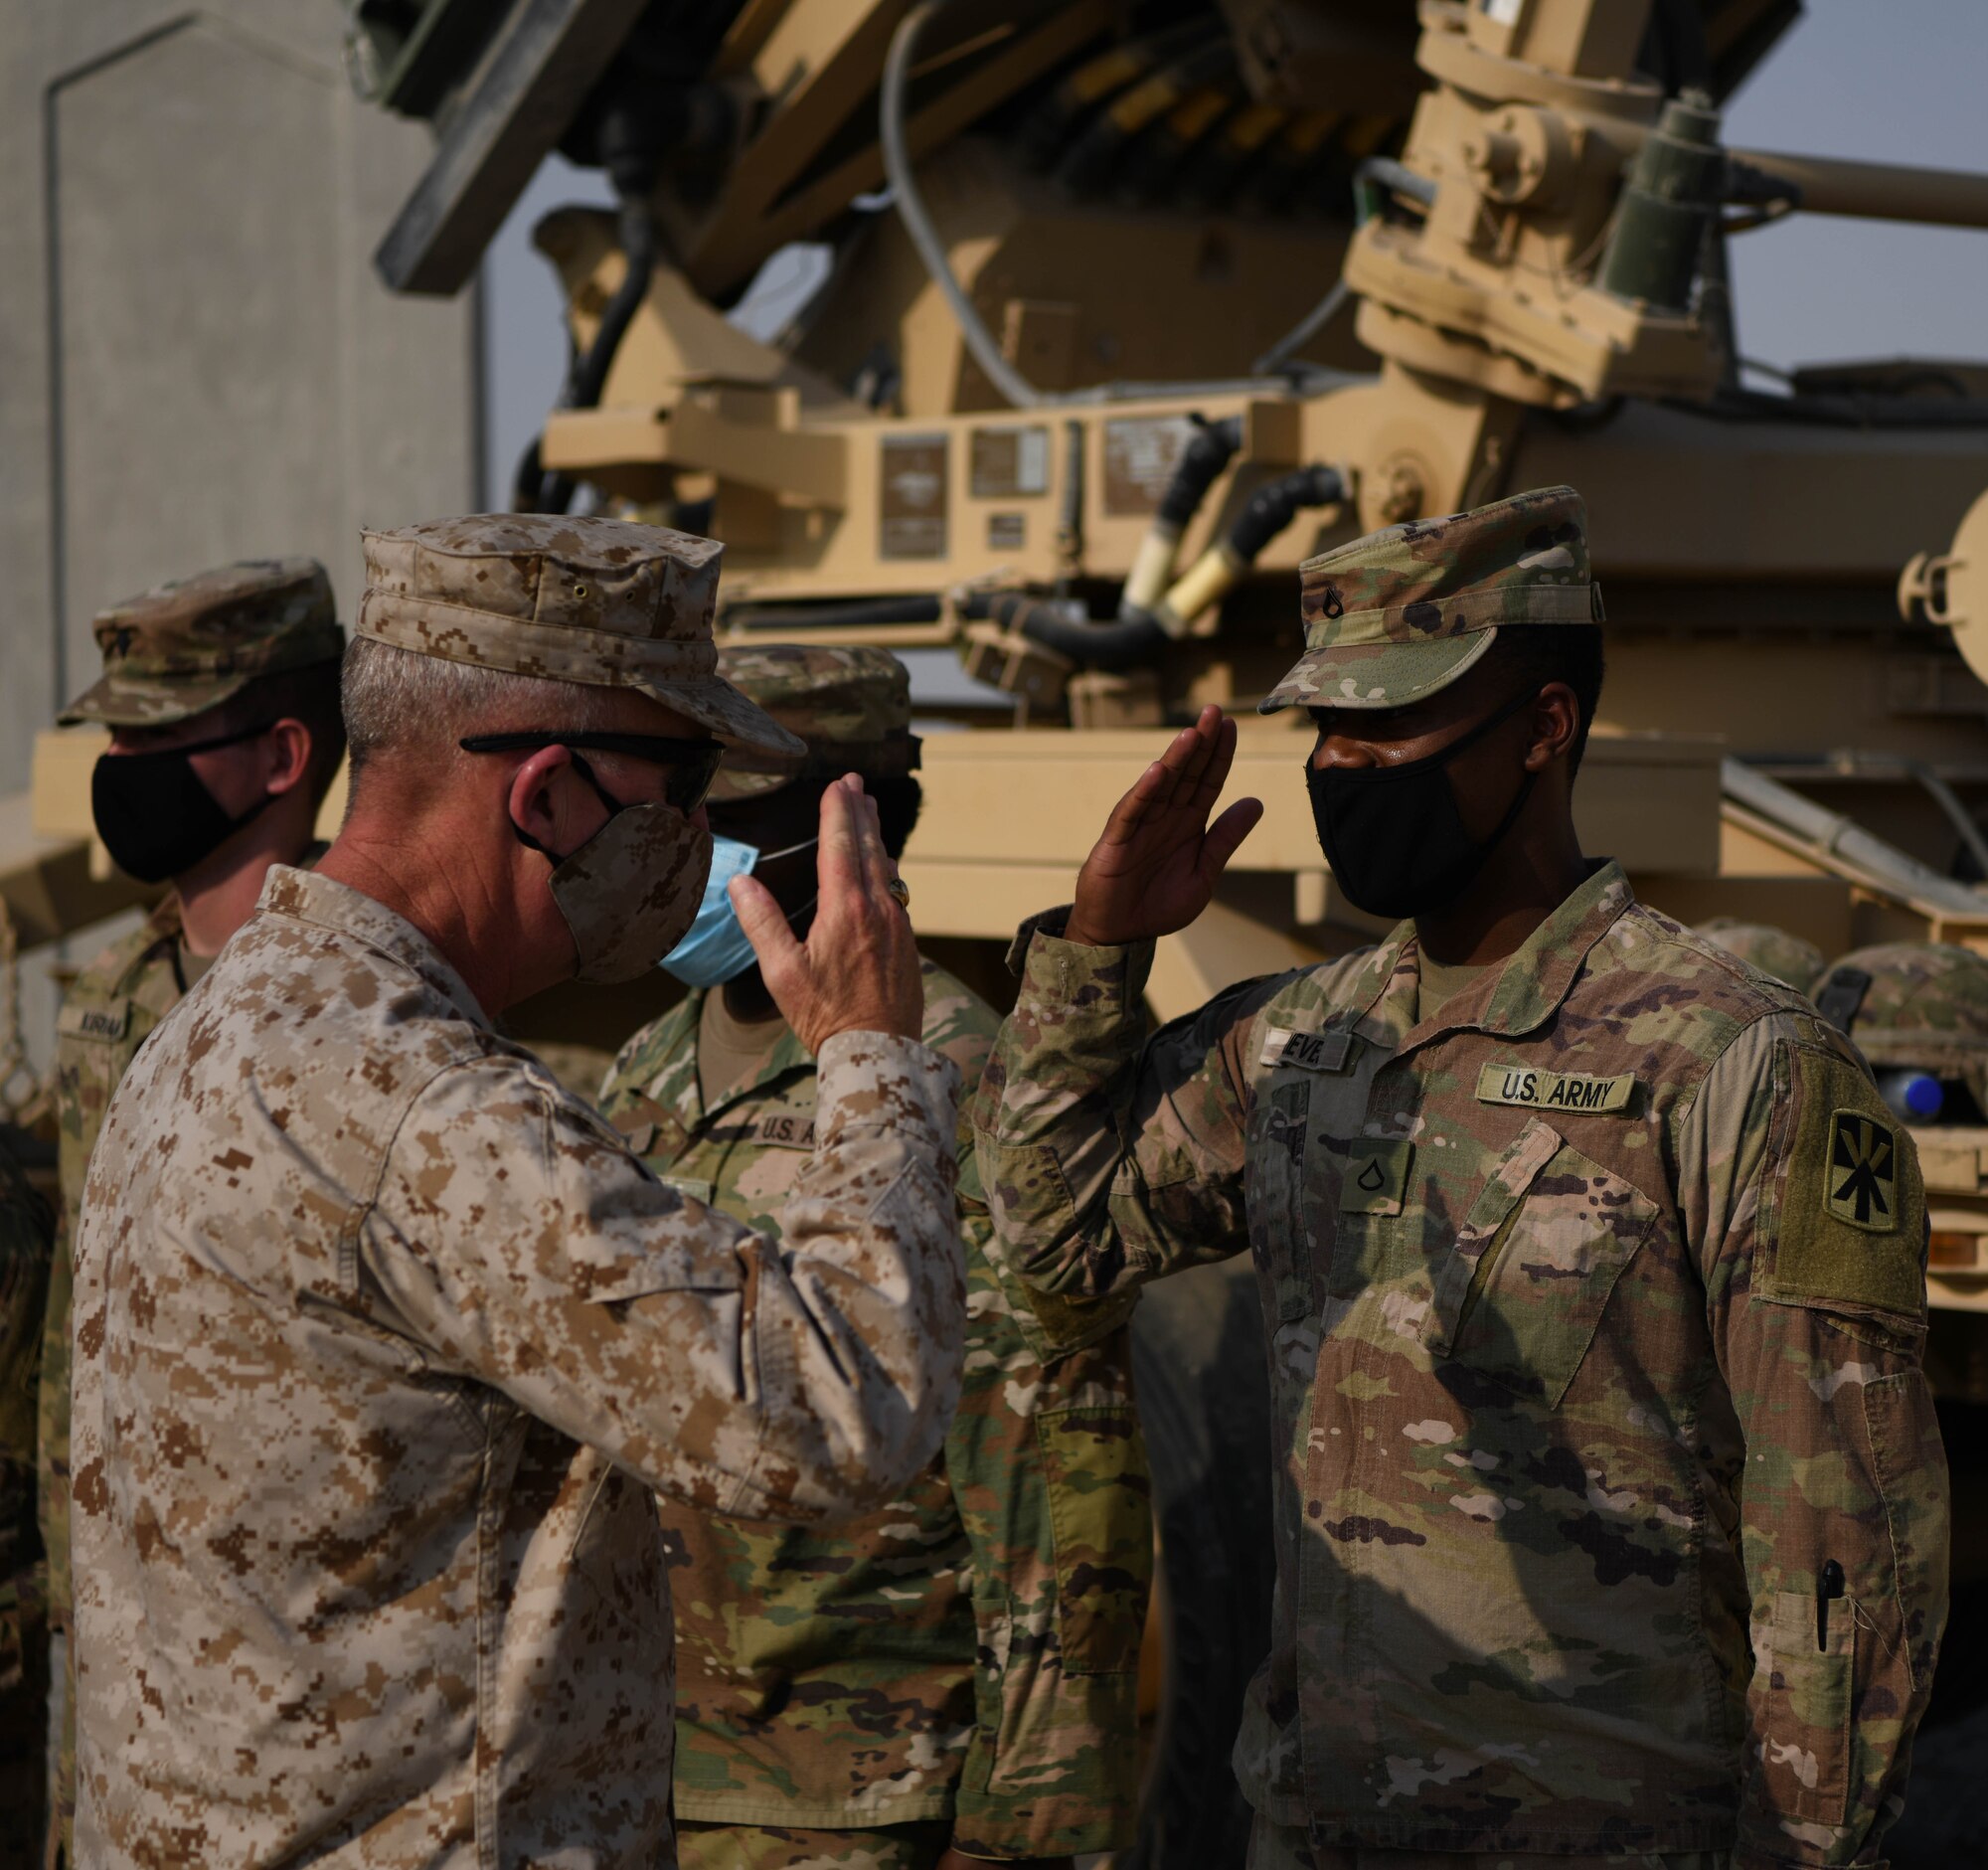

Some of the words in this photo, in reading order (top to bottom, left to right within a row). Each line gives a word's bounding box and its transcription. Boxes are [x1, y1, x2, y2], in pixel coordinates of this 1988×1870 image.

[1502, 1073, 1539, 1102] U.S.
[1548, 1079, 1615, 1106] ARMY
[763, 1117, 793, 1141] U.S.
